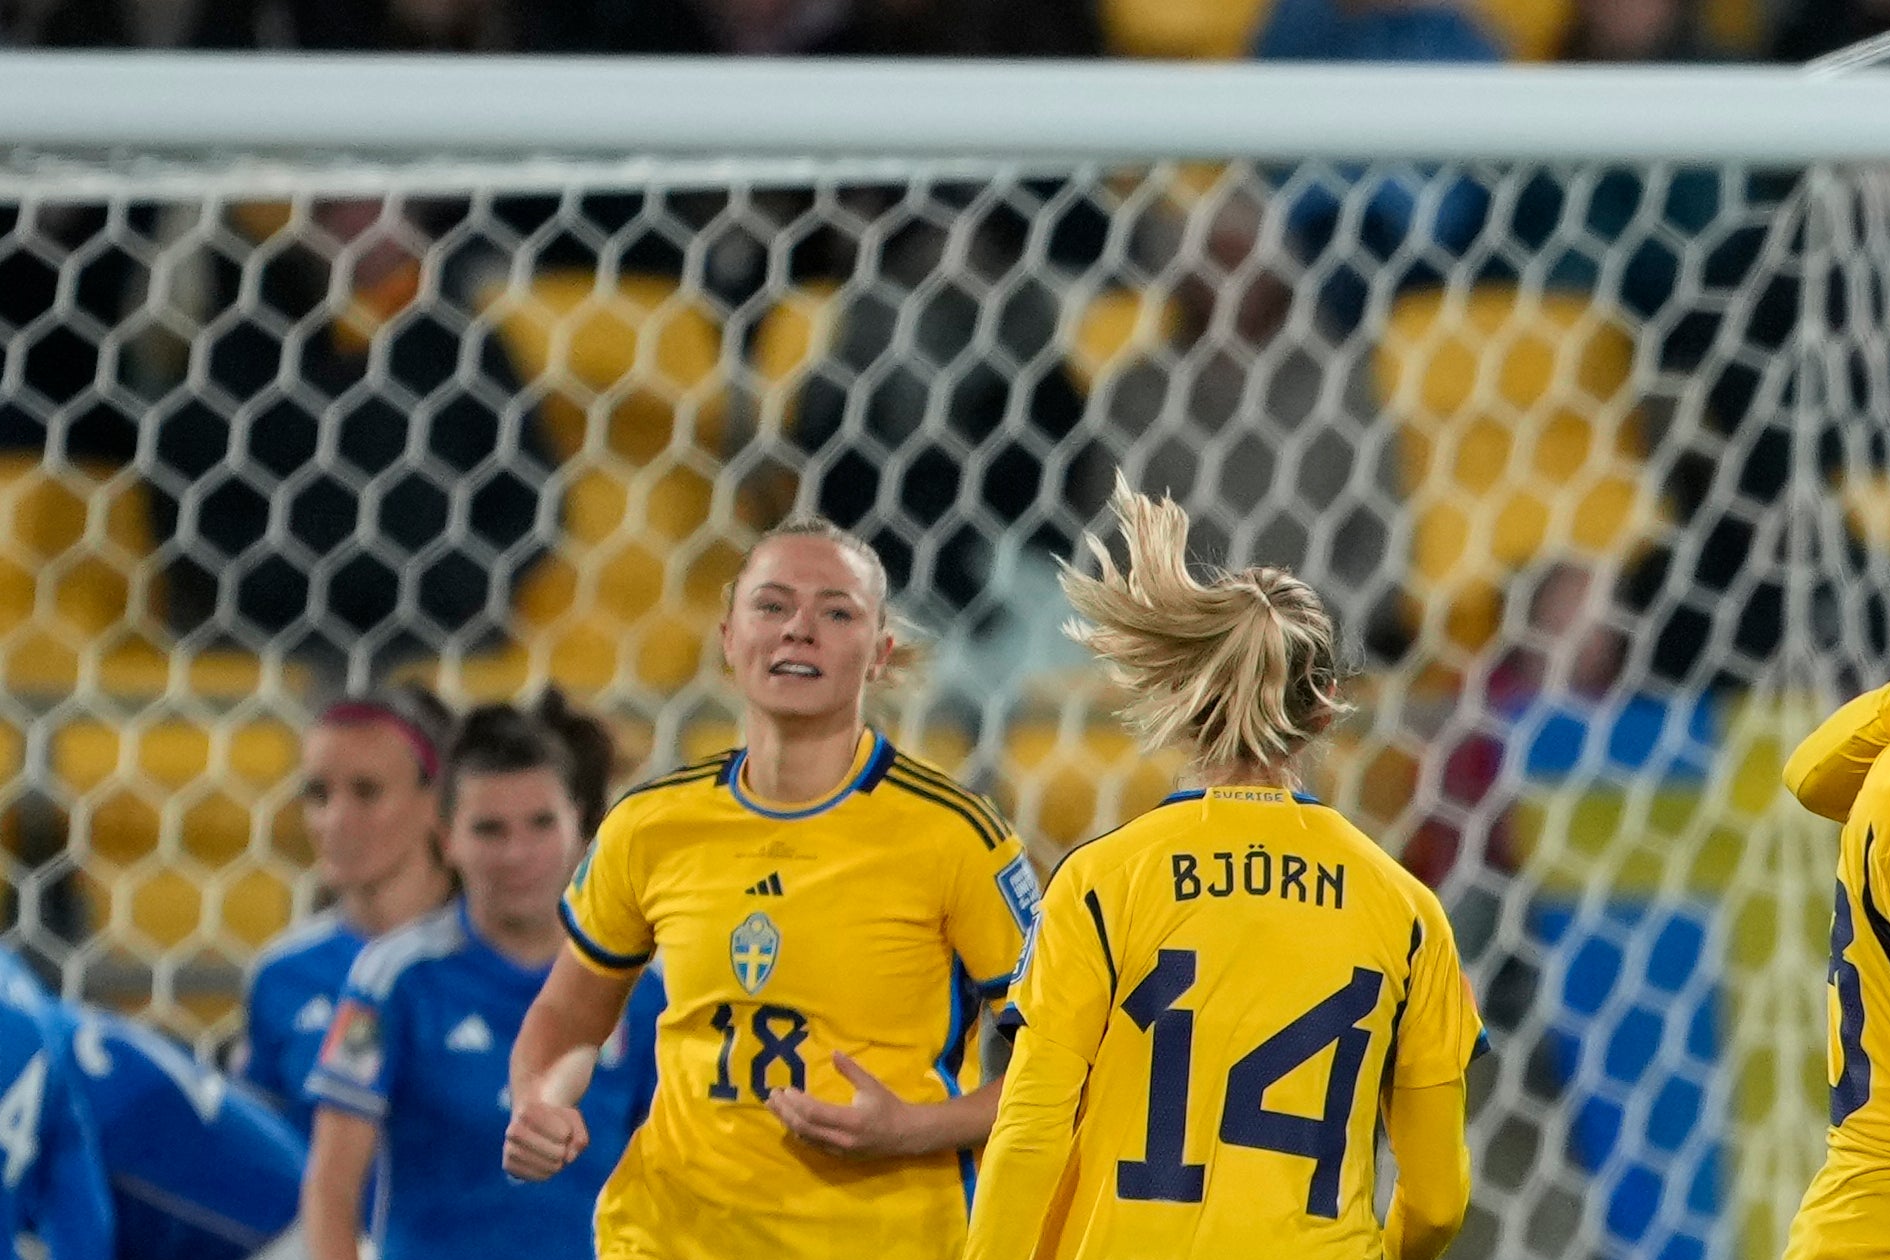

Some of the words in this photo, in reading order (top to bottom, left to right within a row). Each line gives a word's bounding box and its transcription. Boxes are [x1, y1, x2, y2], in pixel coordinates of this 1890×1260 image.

[1212, 790, 1286, 802] SVERIGE
[1172, 843, 1345, 910] BJÖRN
[708, 1003, 809, 1101] 18
[1117, 949, 1385, 1219] 14
